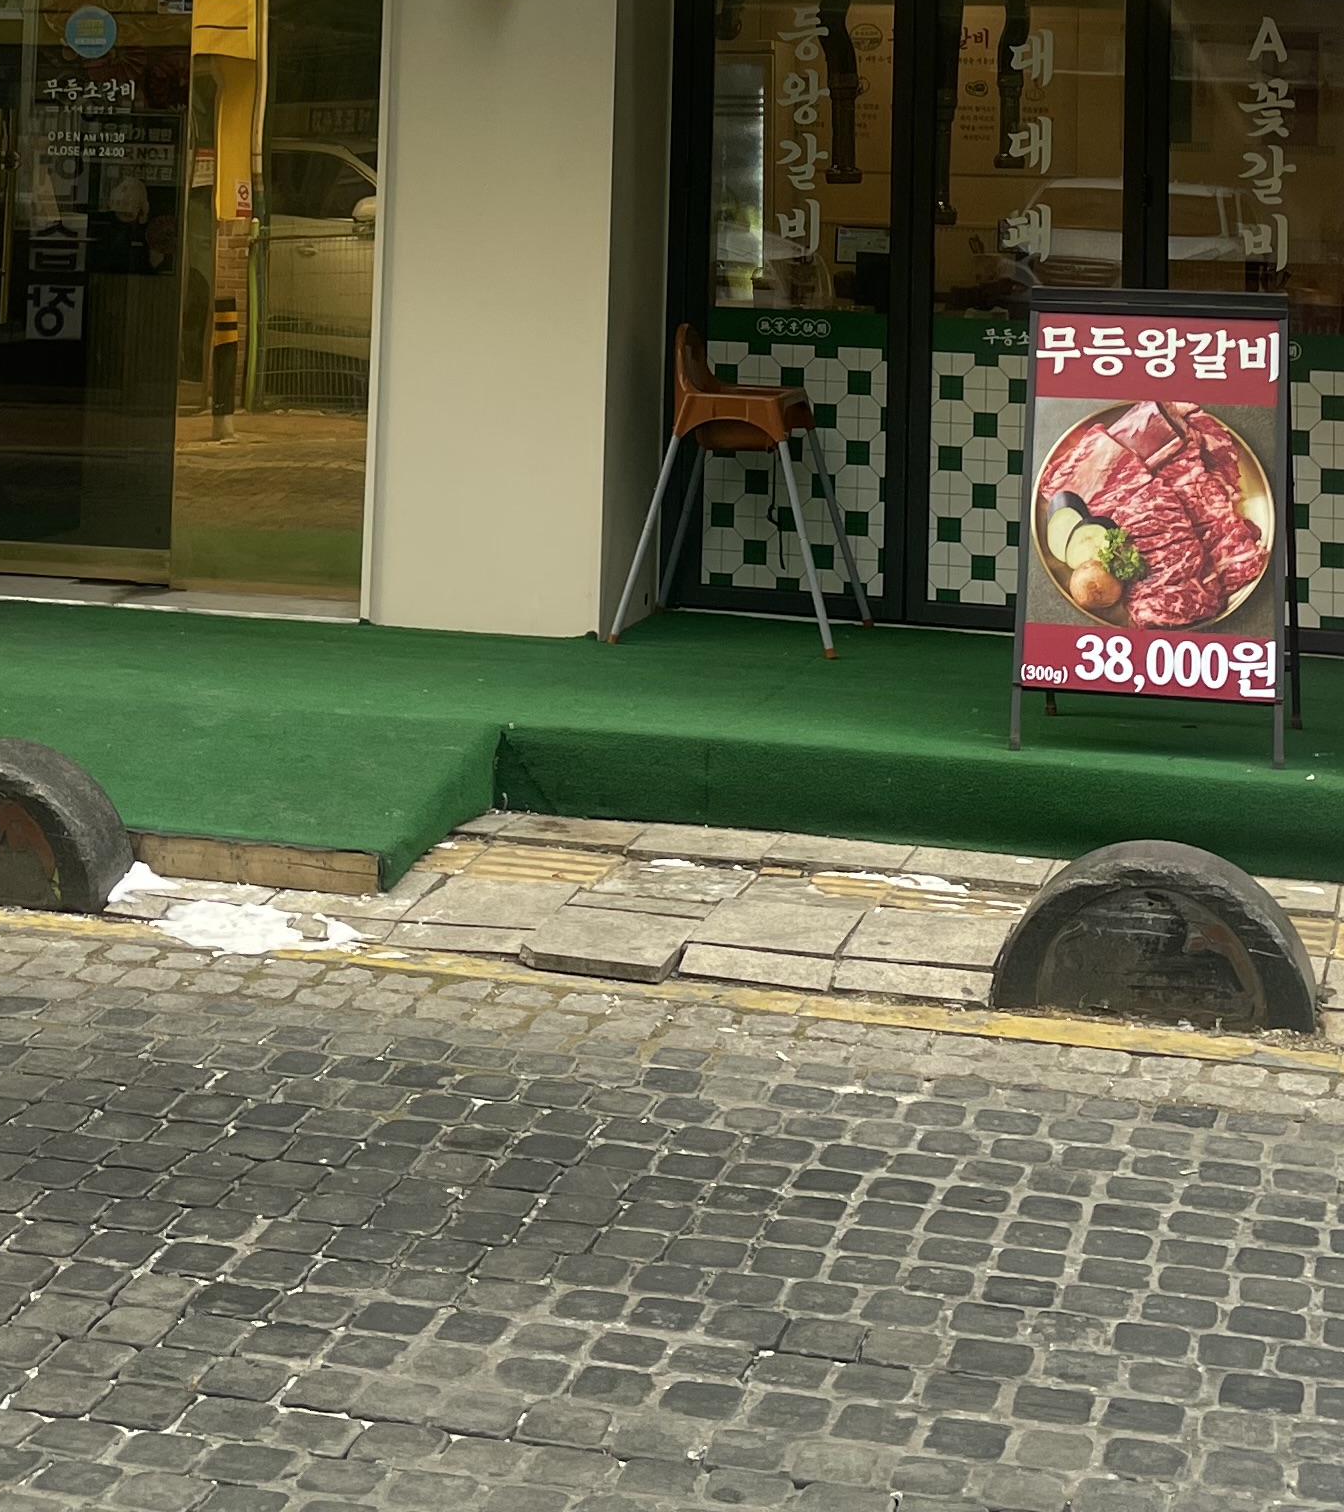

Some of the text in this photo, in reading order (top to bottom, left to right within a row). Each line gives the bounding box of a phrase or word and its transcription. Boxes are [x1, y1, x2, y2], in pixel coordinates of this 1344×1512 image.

[43, 78, 136, 101] 무등소갈비
[48, 132, 81, 142] OPEN
[47, 146, 80, 156] CLOSE
[982, 328, 1030, 347] 무등소
[1035, 325, 1280, 382] 무등왕갈비
[1020, 634, 1277, 698] (300g) 38,000원
